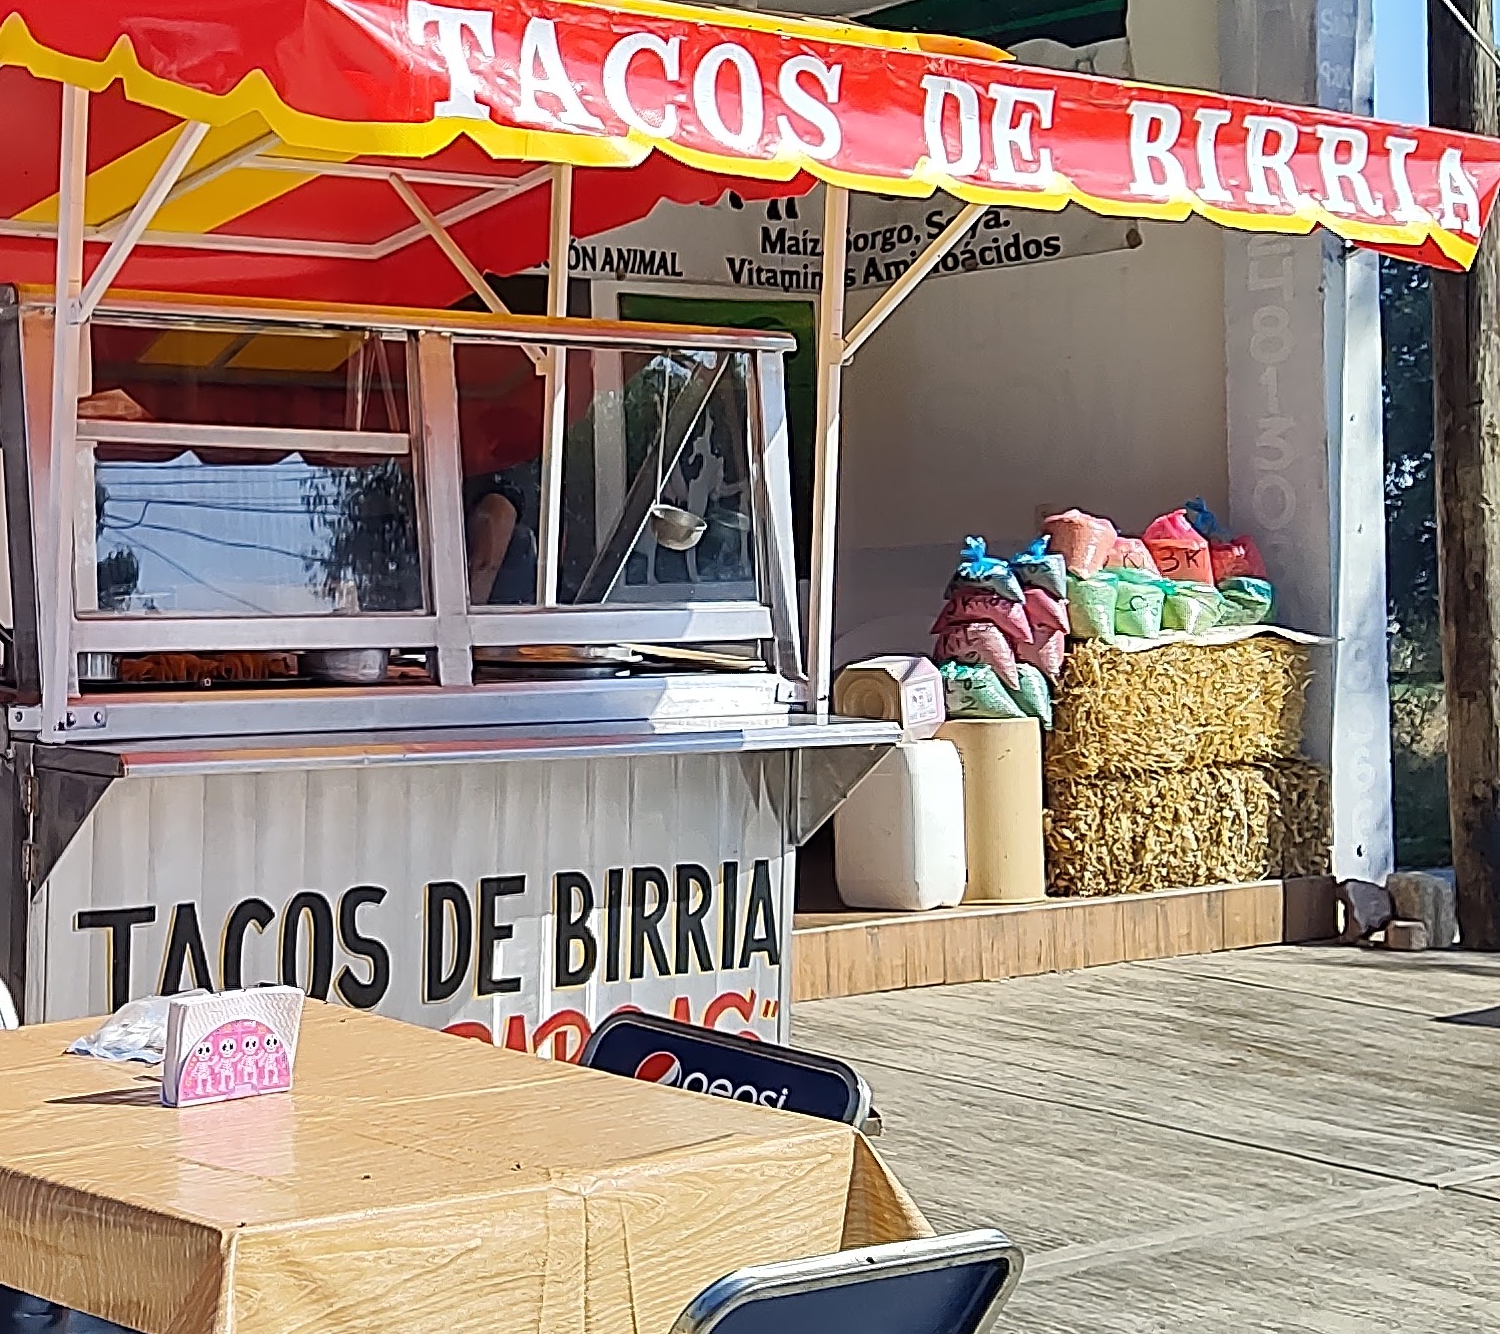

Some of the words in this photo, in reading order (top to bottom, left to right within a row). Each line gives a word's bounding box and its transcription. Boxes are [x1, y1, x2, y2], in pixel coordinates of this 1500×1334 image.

[406, 0, 843, 161] TACOS
[920, 74, 1056, 187] DE
[1126, 101, 1482, 240] BIRRIA
[600, 246, 683, 278] ANIMAL
[725, 256, 857, 291] Vitamins
[862, 232, 1062, 285] Amioácidos
[73, 884, 392, 1015] TACOS
[422, 874, 527, 1004] DE
[551, 858, 781, 990] BIRRIA
